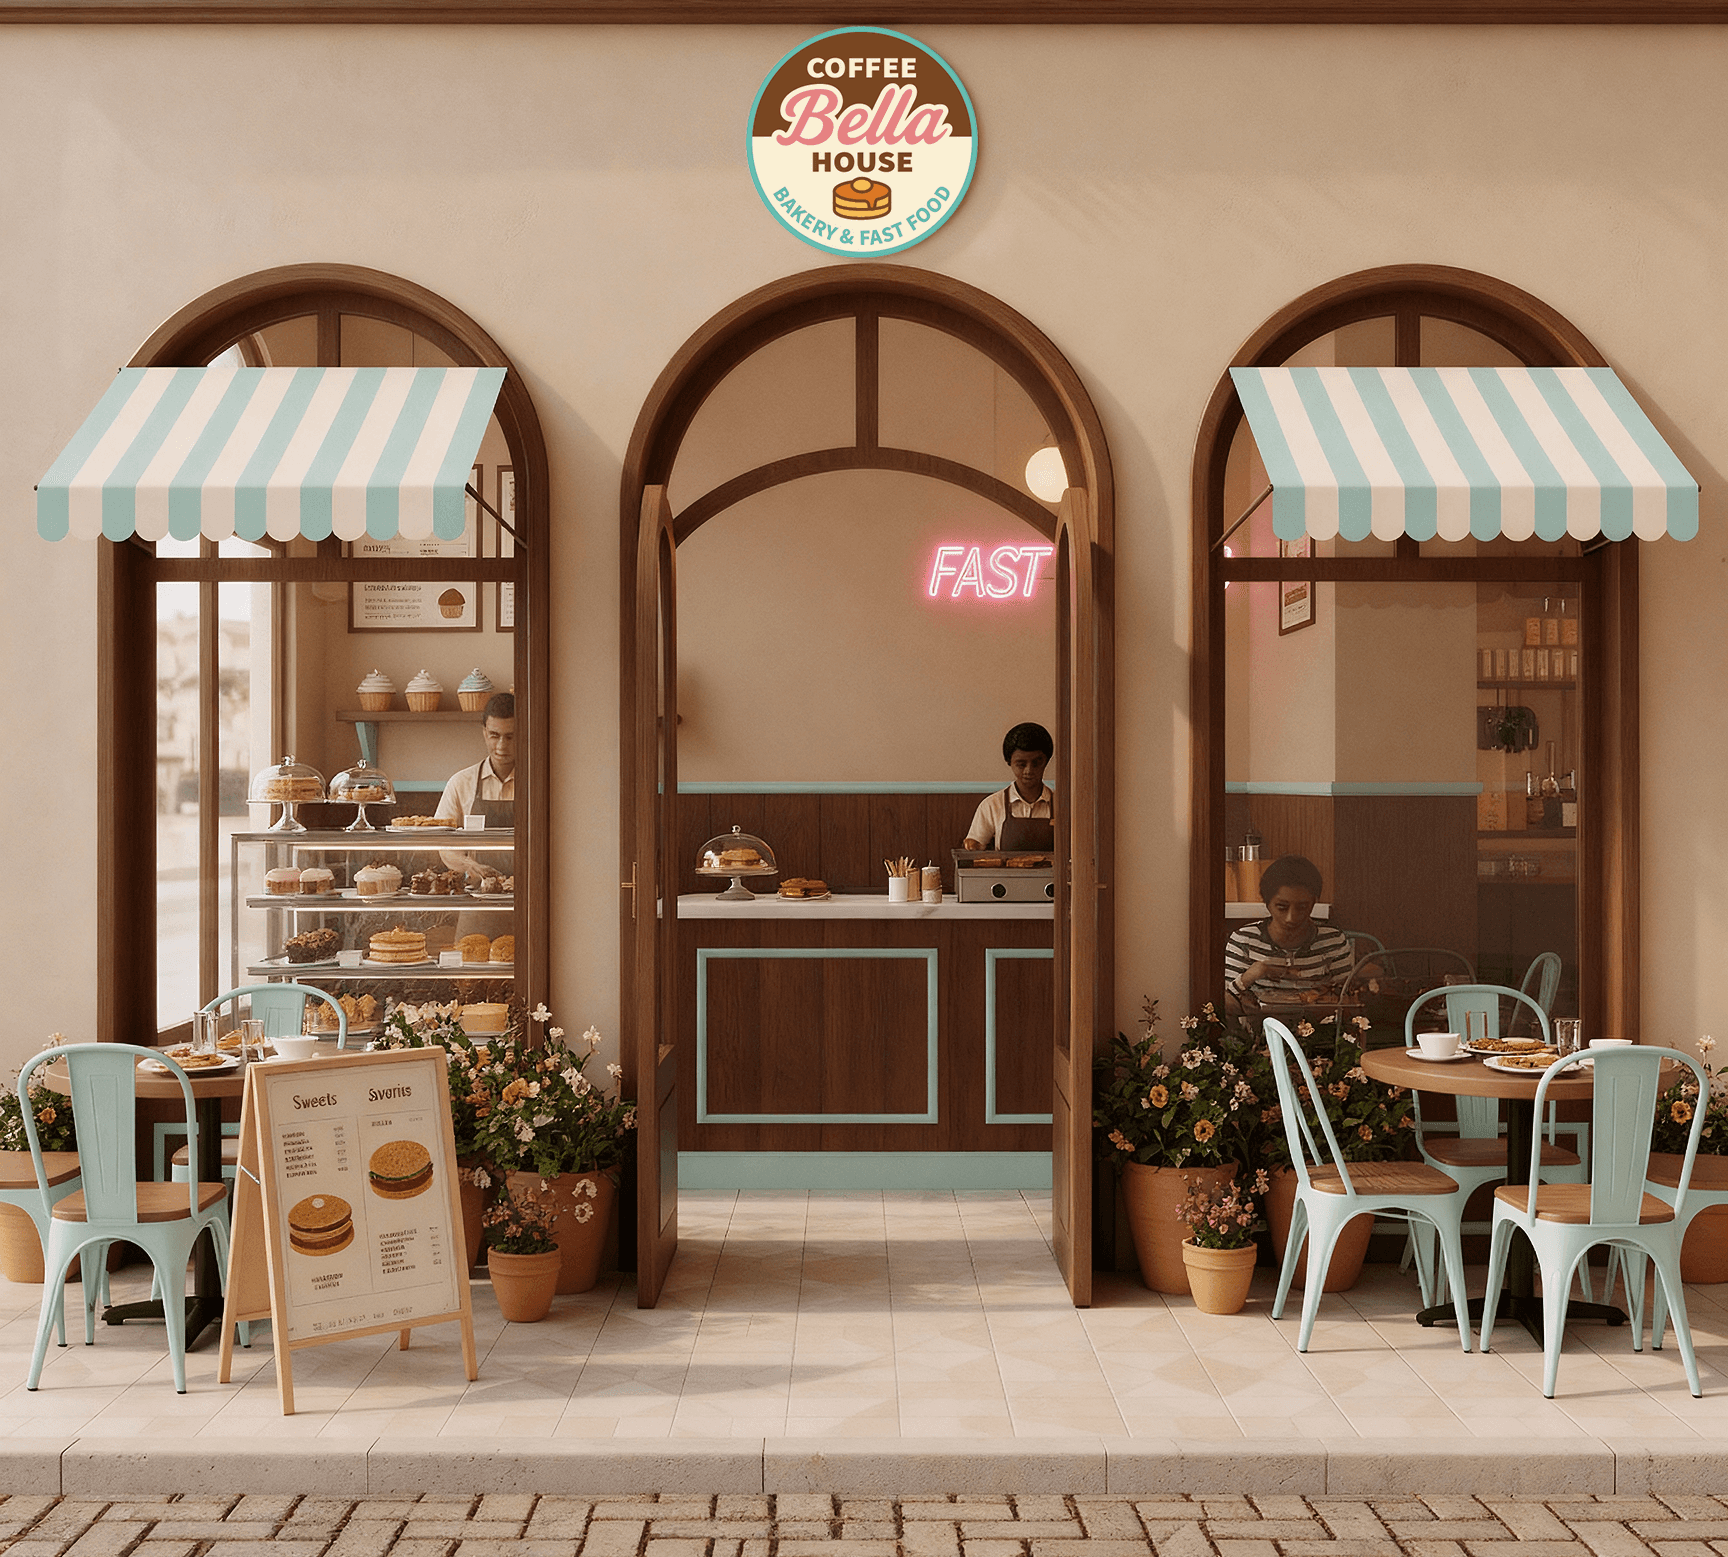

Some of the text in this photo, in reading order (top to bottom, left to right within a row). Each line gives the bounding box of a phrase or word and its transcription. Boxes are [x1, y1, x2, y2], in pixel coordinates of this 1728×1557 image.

[806, 57, 917, 79] COFFEE
[775, 86, 950, 147] Bella
[811, 152, 913, 173] HOUSE
[772, 186, 951, 246] BAKERY & FAST FOOD
[928, 545, 1054, 599] FAST
